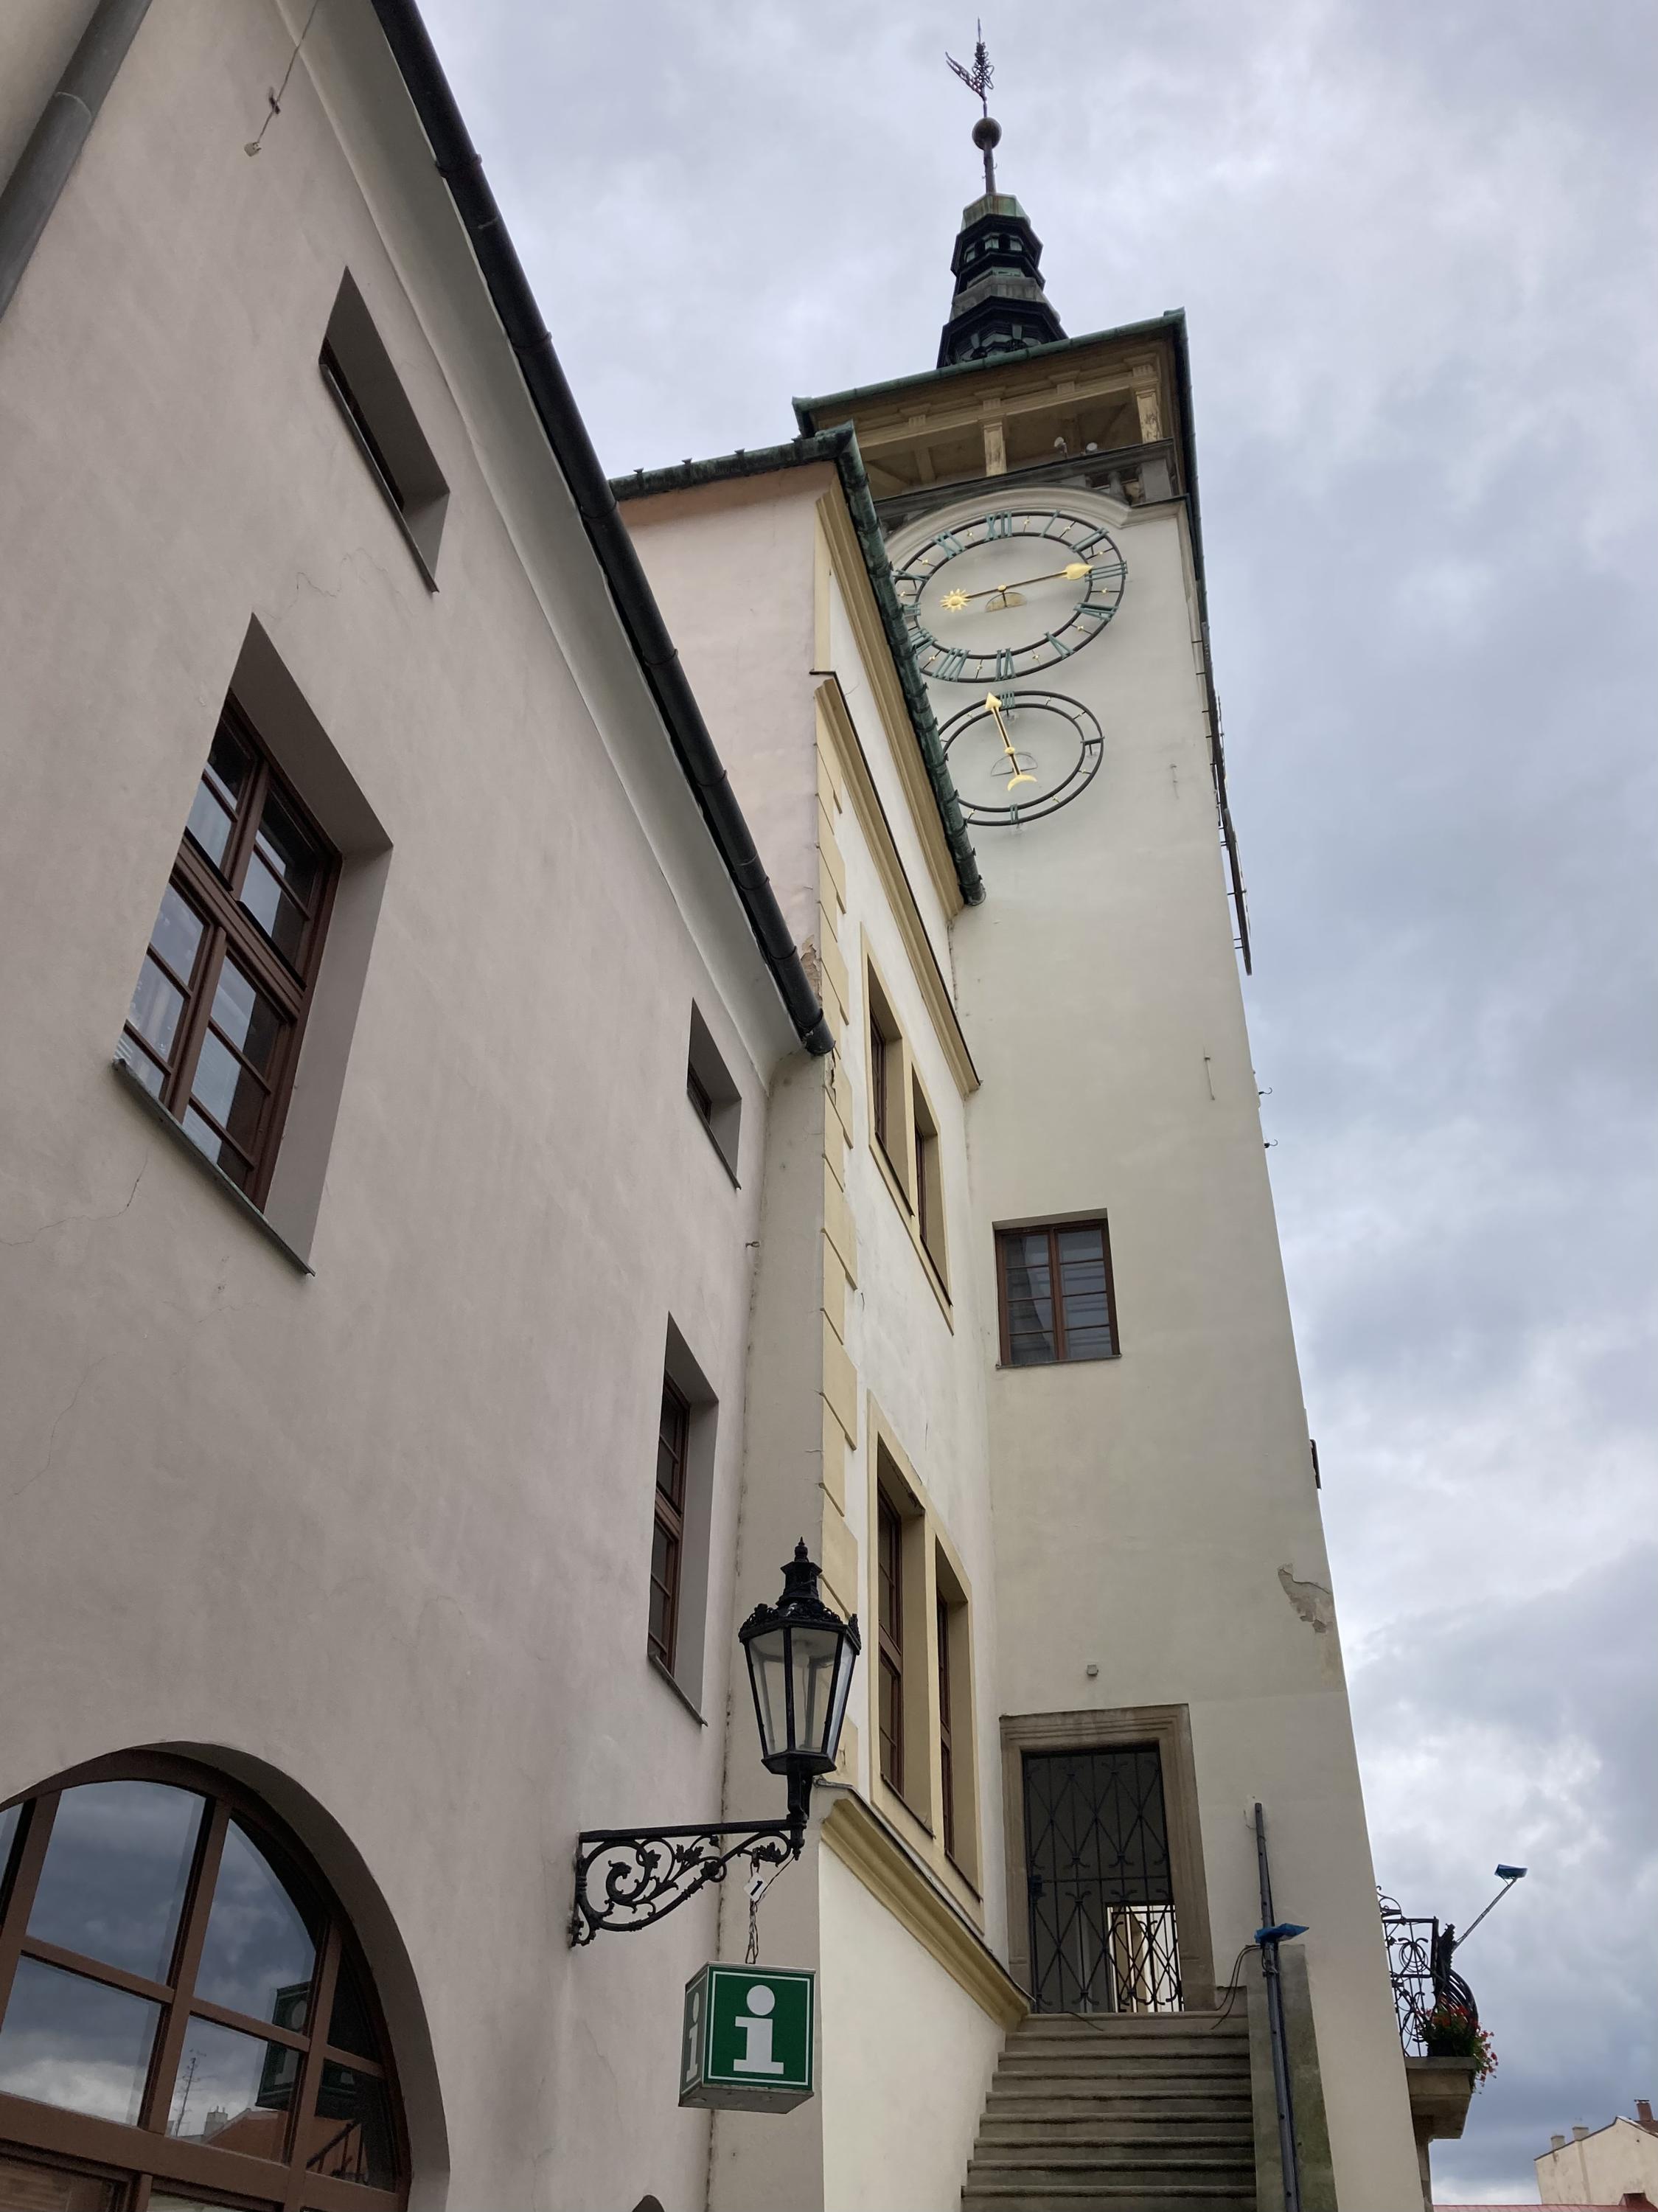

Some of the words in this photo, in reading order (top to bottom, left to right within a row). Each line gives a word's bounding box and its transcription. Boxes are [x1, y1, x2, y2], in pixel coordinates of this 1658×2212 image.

[984, 509, 1013, 542] XII
[1040, 509, 1062, 538] I
[1044, 631, 1075, 660] V
[750, 1879, 763, 1896] 1
